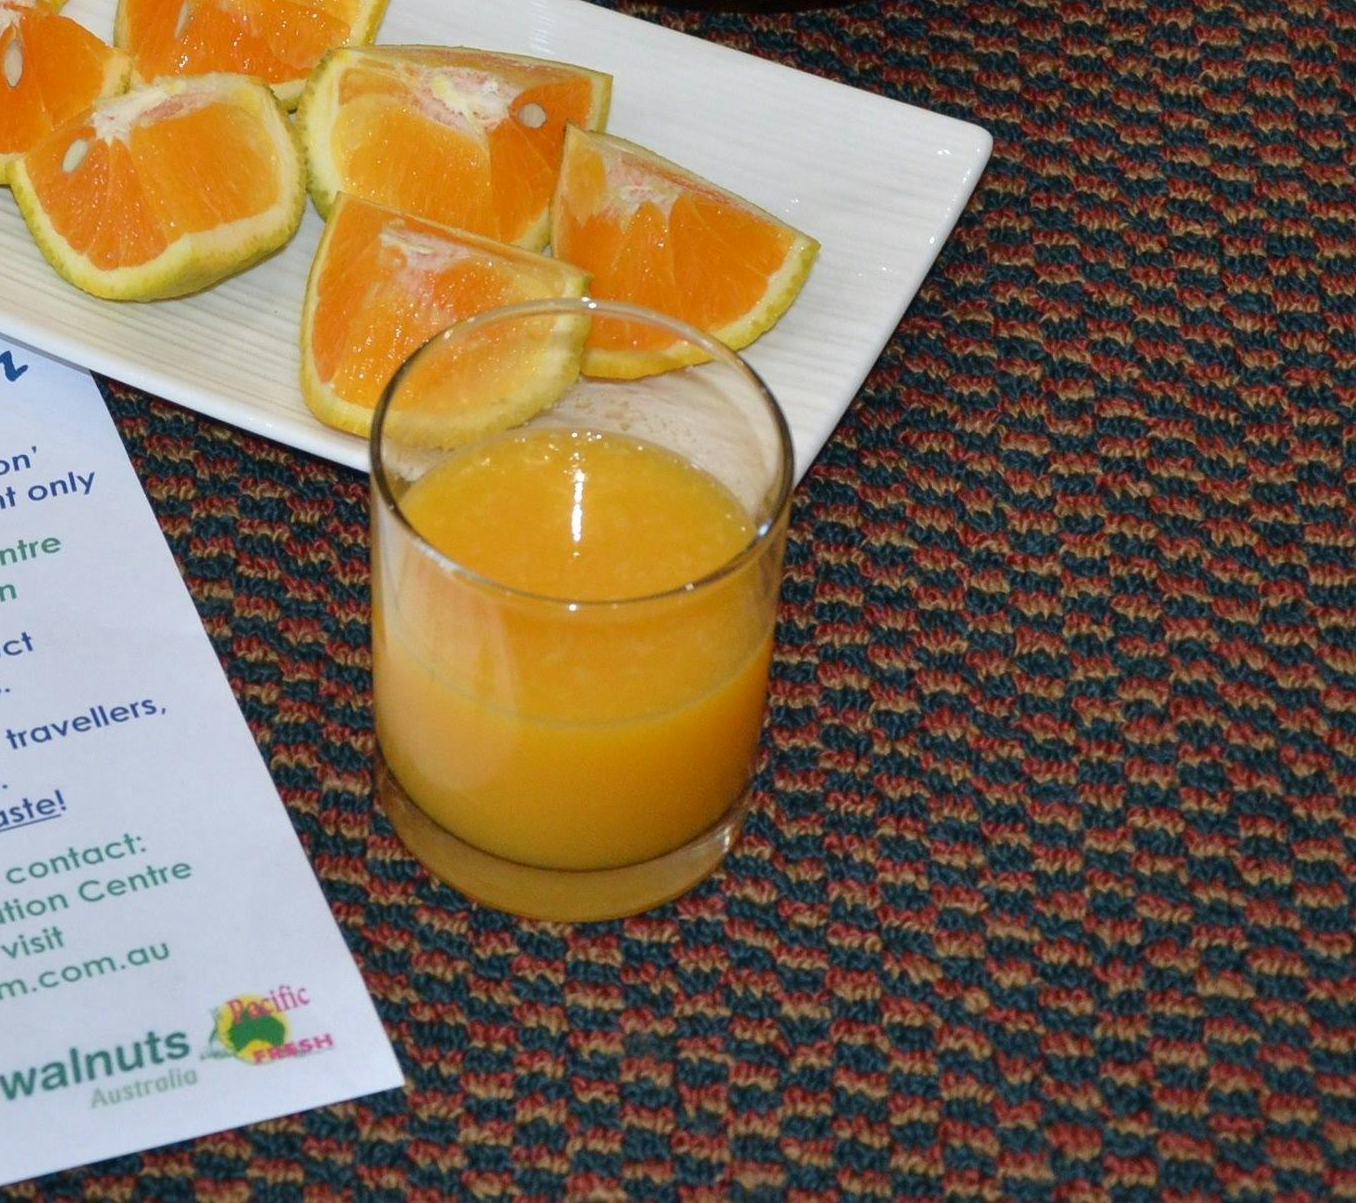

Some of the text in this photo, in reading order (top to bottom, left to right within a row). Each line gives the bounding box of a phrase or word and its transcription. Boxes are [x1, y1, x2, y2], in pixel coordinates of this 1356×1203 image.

[27, 471, 96, 502] only
[5, 699, 167, 750] travellers,
[5, 833, 147, 885] contact:
[78, 862, 192, 903] Centre
[0, 926, 64, 959] visit
[227, 984, 310, 1025] Pacific
[252, 1033, 333, 1065] FRESH
[90, 1068, 198, 1109] Australia
